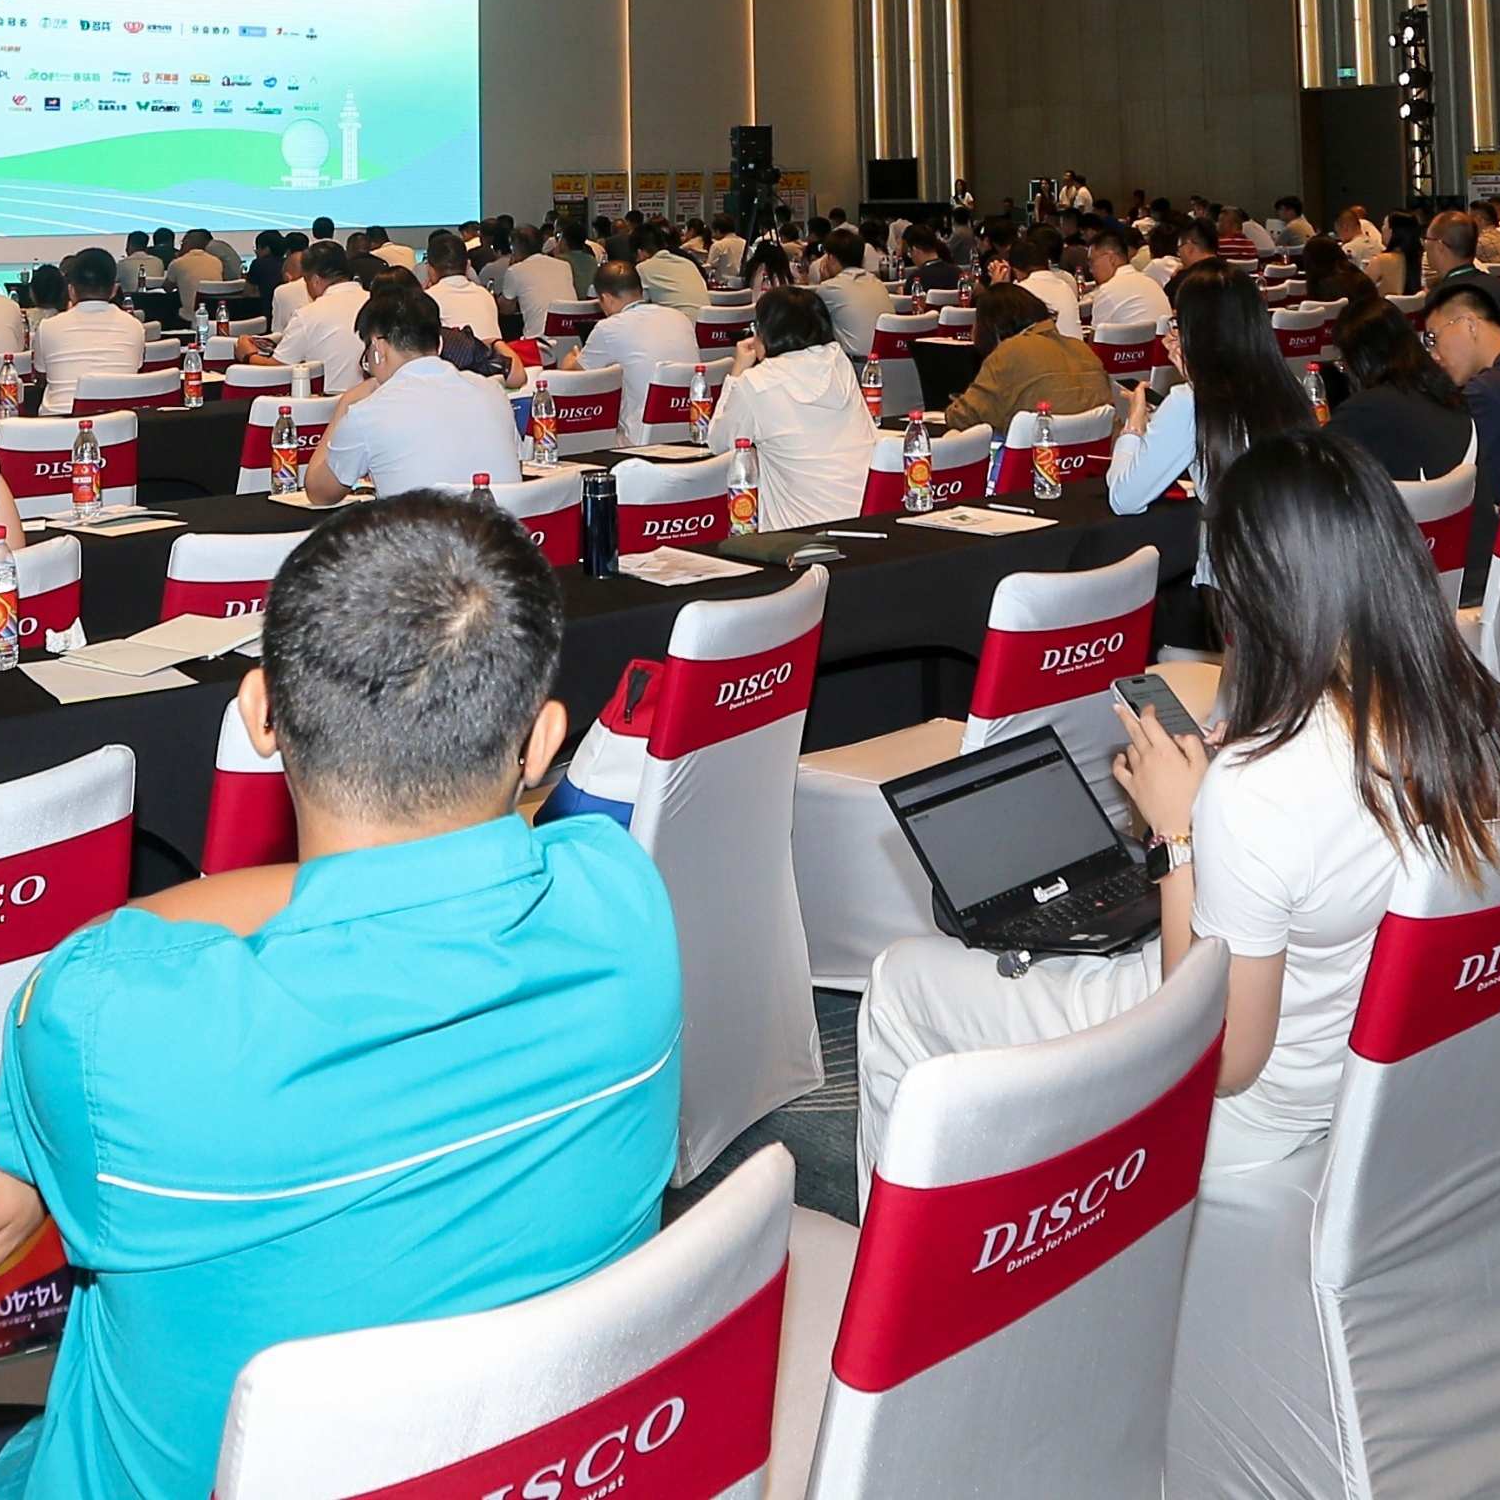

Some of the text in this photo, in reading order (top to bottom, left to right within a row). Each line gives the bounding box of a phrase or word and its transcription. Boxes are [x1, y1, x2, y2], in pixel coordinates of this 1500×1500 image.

[1114, 350, 1145, 362] DISCO
[558, 405, 603, 420] DISCO
[642, 514, 715, 536] DISCO
[1040, 632, 1124, 671] DISCO
[714, 662, 792, 707] DISCO
[972, 1147, 1146, 1274] DISCO
[1006, 1208, 1106, 1274] Dance for harvest
